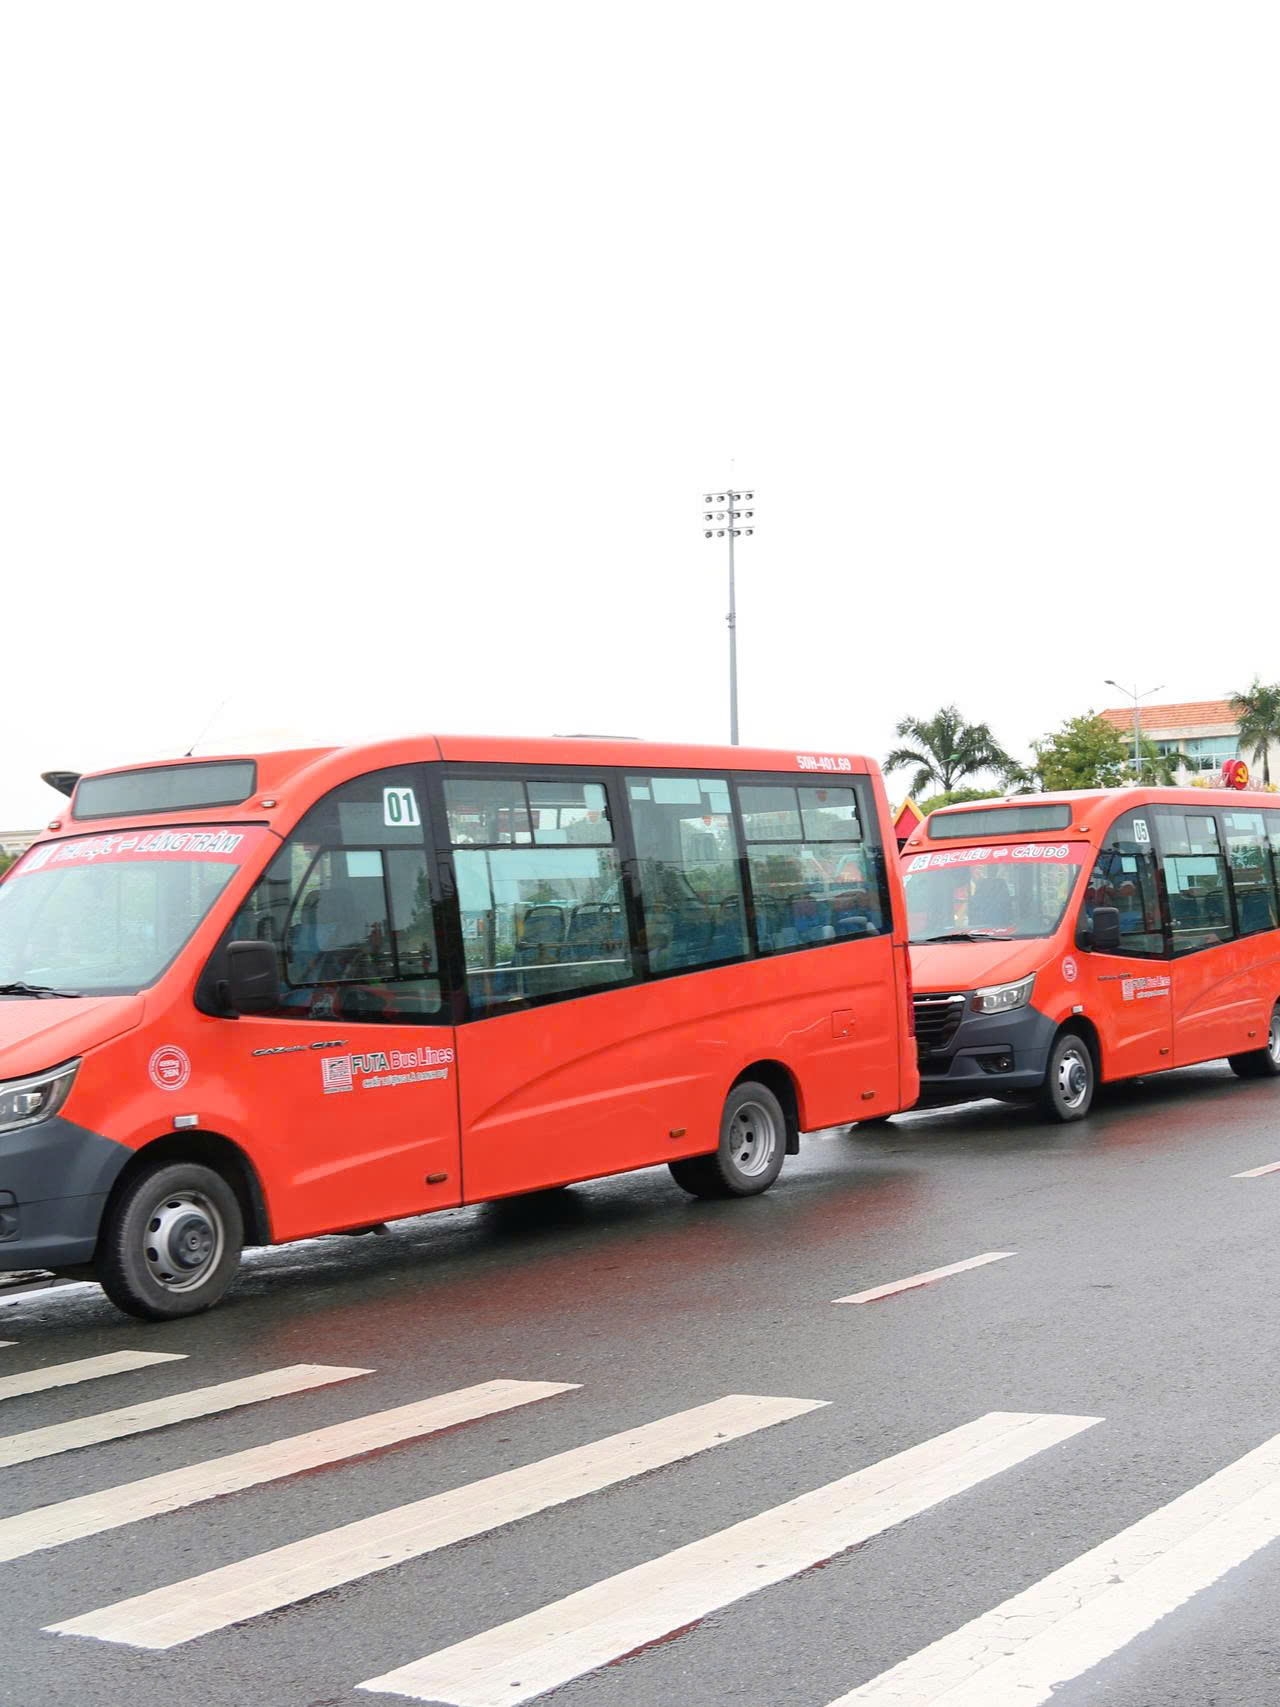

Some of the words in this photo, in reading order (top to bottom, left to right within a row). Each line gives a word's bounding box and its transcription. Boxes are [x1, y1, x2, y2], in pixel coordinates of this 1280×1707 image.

[387, 791, 414, 822] 01
[1135, 822, 1148, 841] 05
[352, 1052, 389, 1074] FUTA
[390, 1050, 418, 1070] Bus
[417, 1046, 454, 1066] Lines
